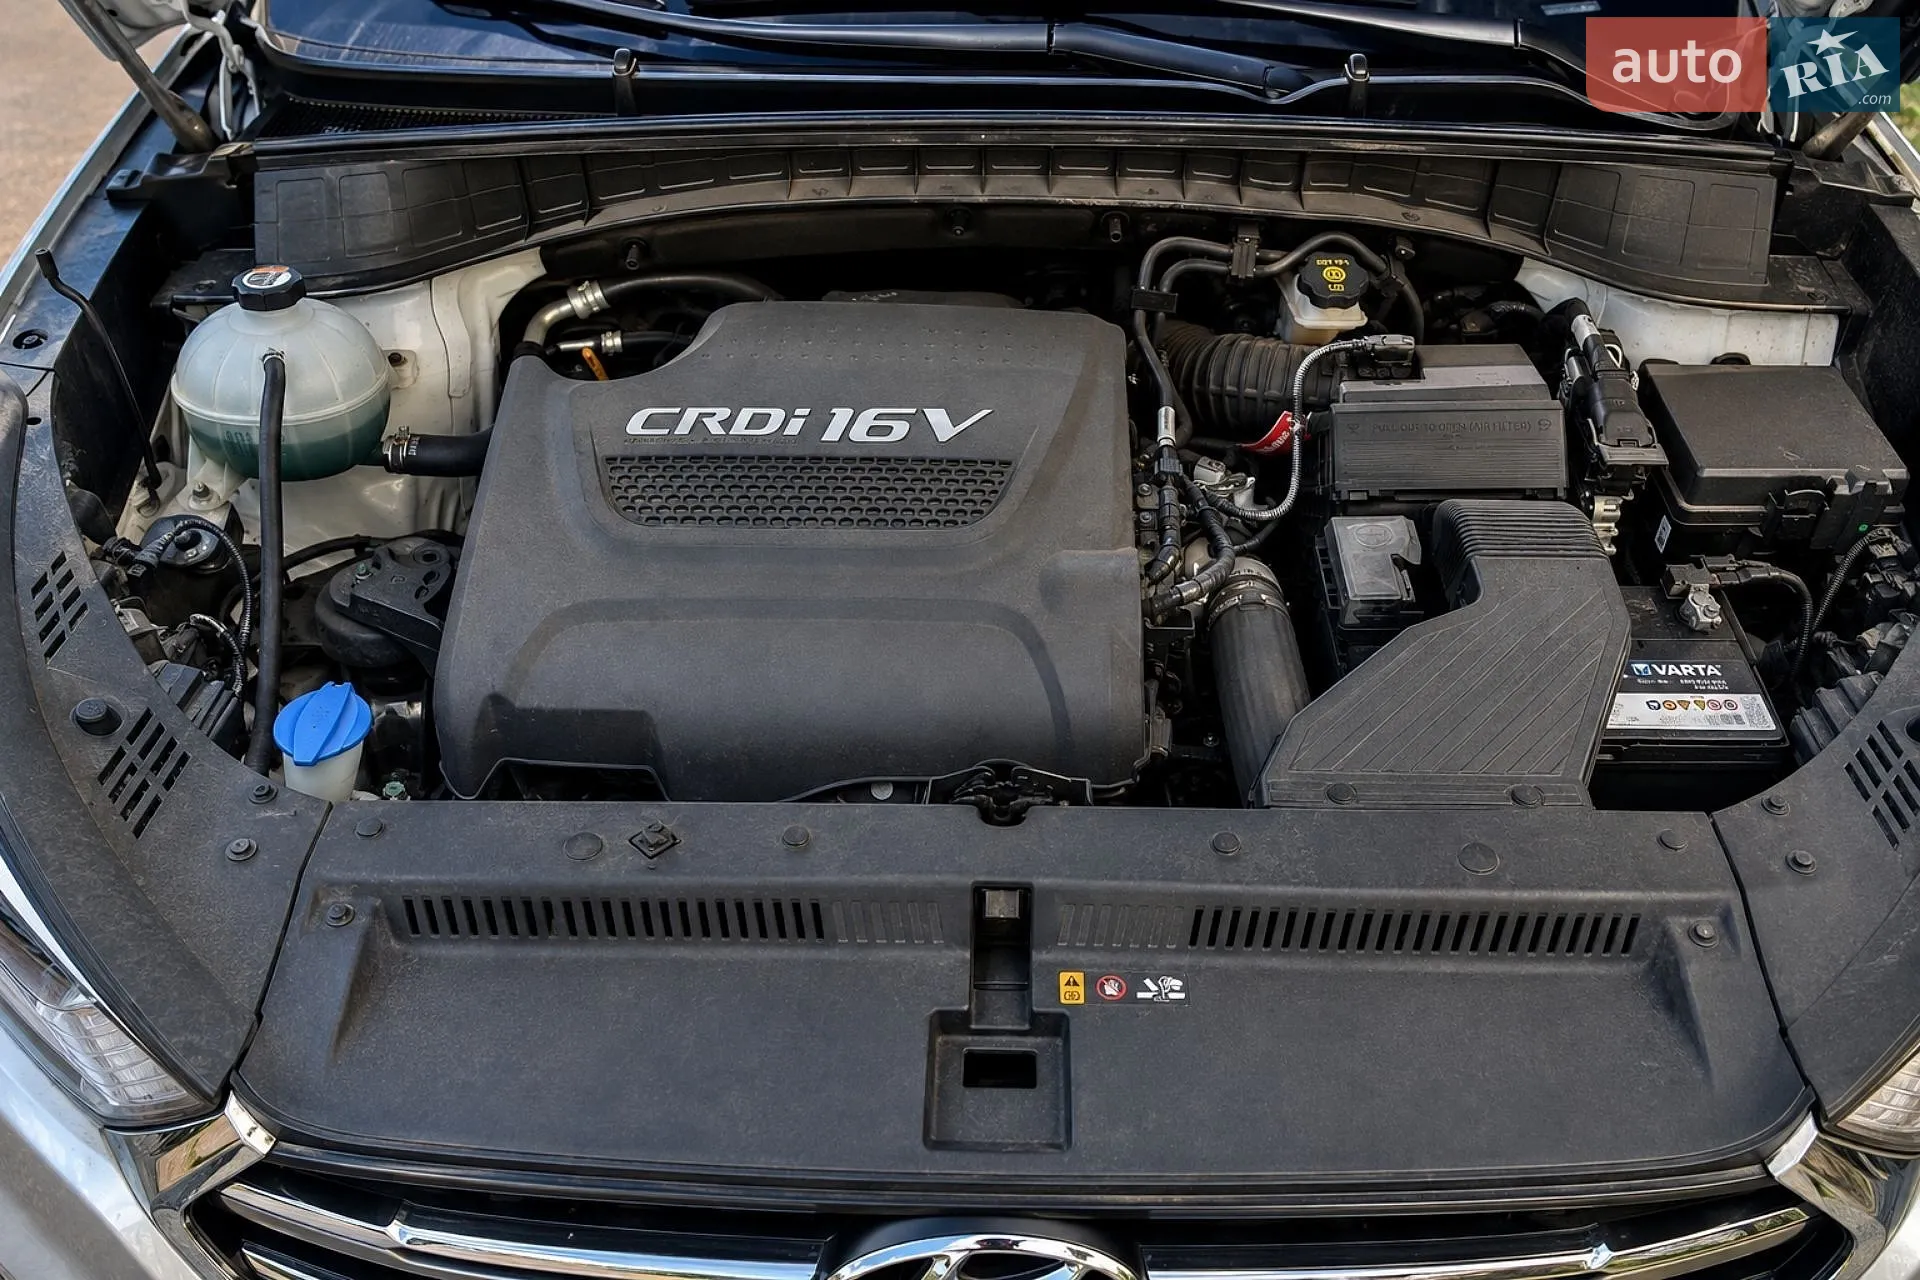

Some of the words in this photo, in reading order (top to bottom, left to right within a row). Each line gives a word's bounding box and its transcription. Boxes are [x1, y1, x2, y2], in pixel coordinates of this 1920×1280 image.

[625, 407, 811, 436] CRDi
[820, 407, 993, 442] 16V
[1651, 663, 1723, 676] VARTA
